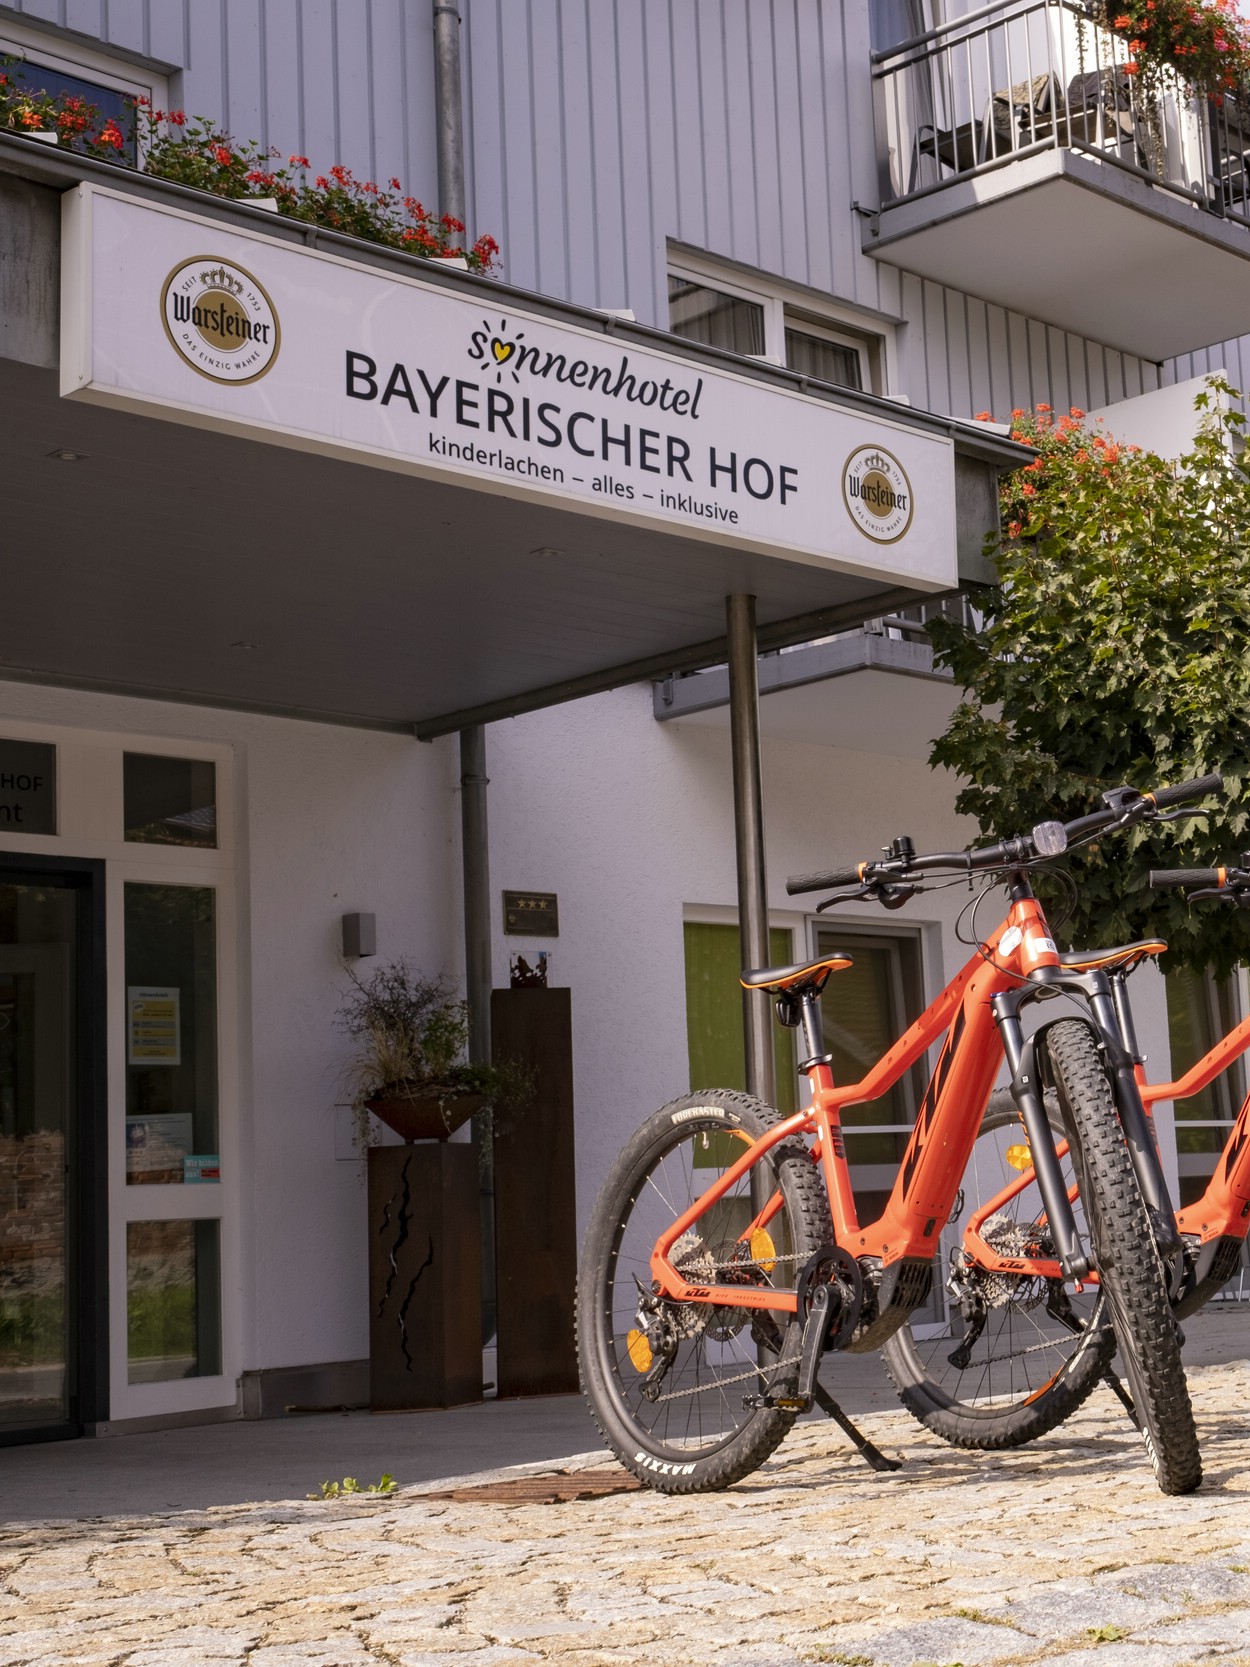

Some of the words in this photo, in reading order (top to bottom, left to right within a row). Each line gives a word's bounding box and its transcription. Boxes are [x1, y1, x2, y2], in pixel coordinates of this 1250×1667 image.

[182, 276, 197, 292] SEIT
[247, 292, 261, 312] 1753
[172, 292, 270, 344] Warsteiner
[182, 333, 197, 351] DAS
[199, 352, 231, 370] EINZIG
[234, 350, 261, 370] WAHRE
[346, 349, 693, 483] BAYERISCHER
[709, 446, 799, 506] HOF
[429, 432, 564, 483] kinderlachen
[591, 474, 635, 500] alles
[660, 488, 739, 524] inklusive
[848, 474, 907, 511] Warsteiner
[1, 773, 43, 792] HOF
[998, 1259, 1026, 1269] KTM
[684, 1287, 711, 1297] KTM
[634, 1452, 697, 1476] MAXXIS
